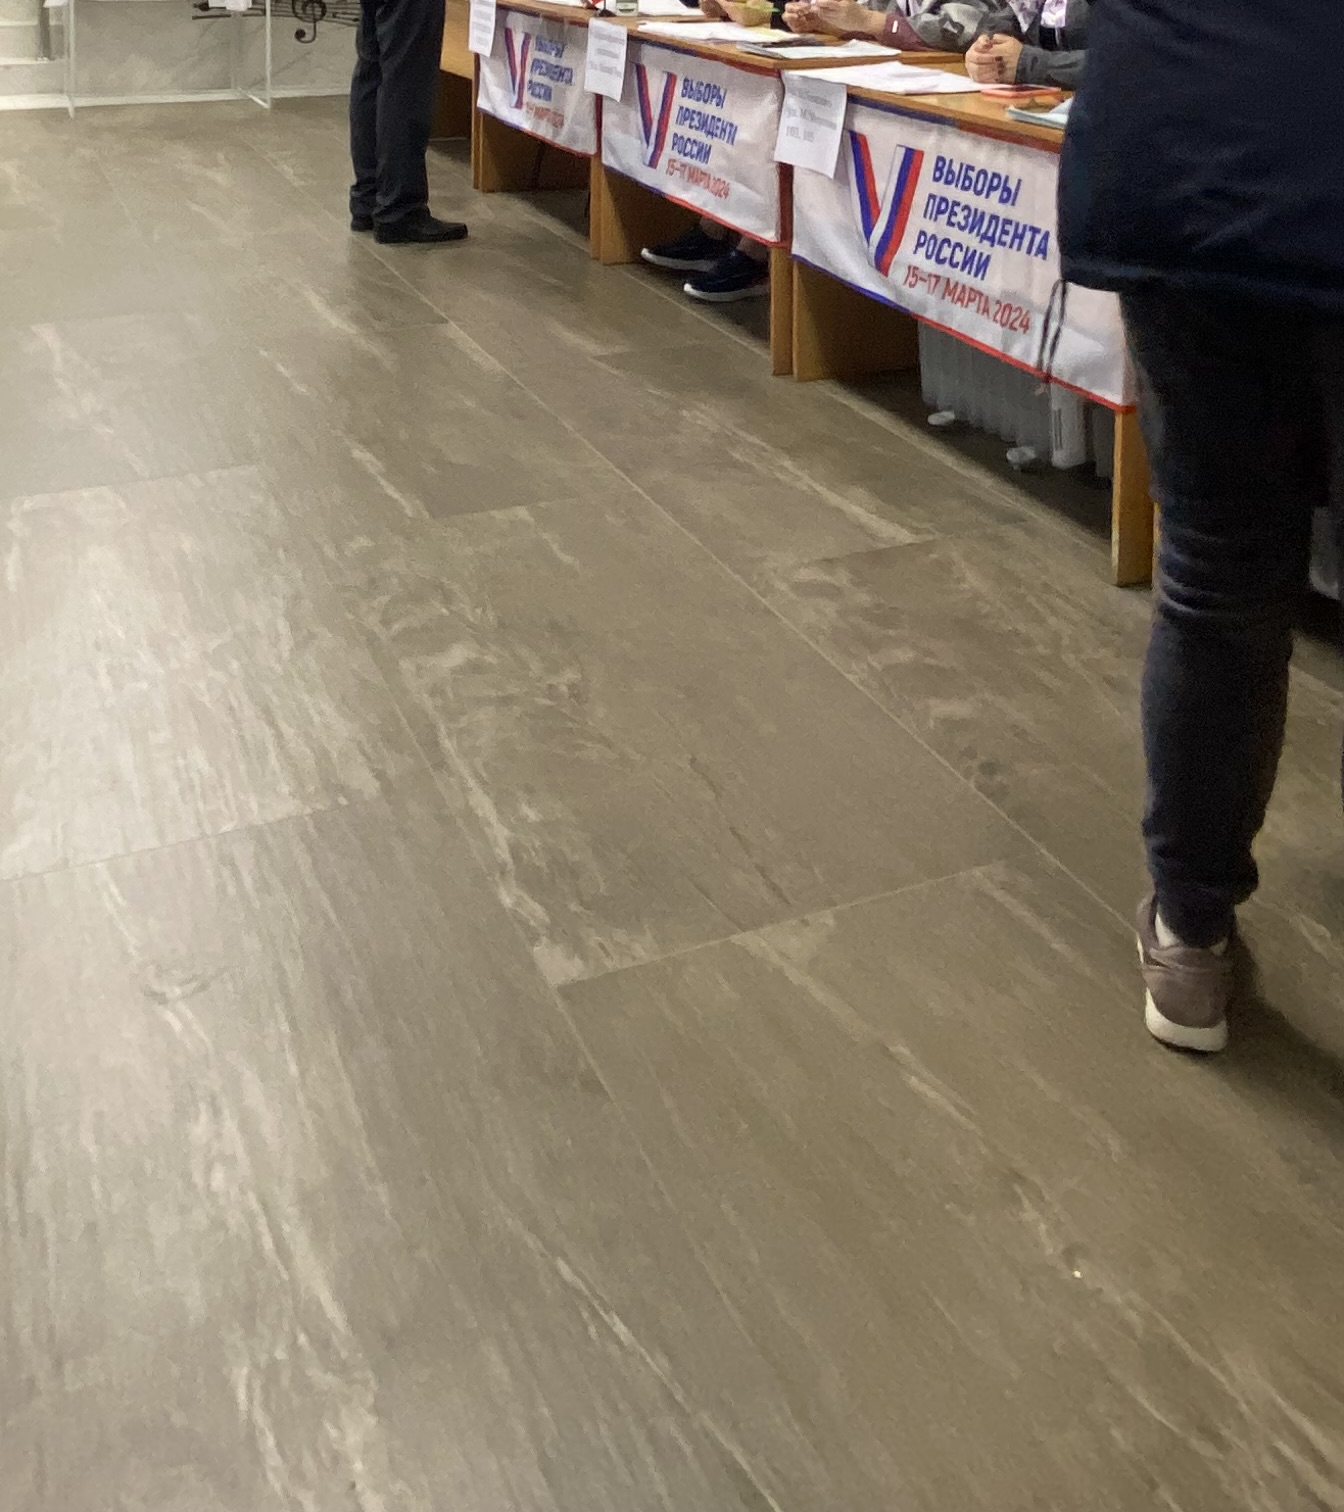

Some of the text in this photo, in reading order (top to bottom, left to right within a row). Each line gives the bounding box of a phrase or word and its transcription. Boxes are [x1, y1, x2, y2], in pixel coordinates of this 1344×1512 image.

[681, 75, 728, 109] ВЫБОРЫ
[671, 132, 712, 165] РОССИИ
[931, 155, 1023, 207] ВЫБОРЫ
[923, 193, 1051, 261] ПРЕЗИДЕНТА
[913, 229, 993, 281] РОССИИ
[941, 277, 991, 318] МАРТА
[992, 299, 1031, 335] 2024
